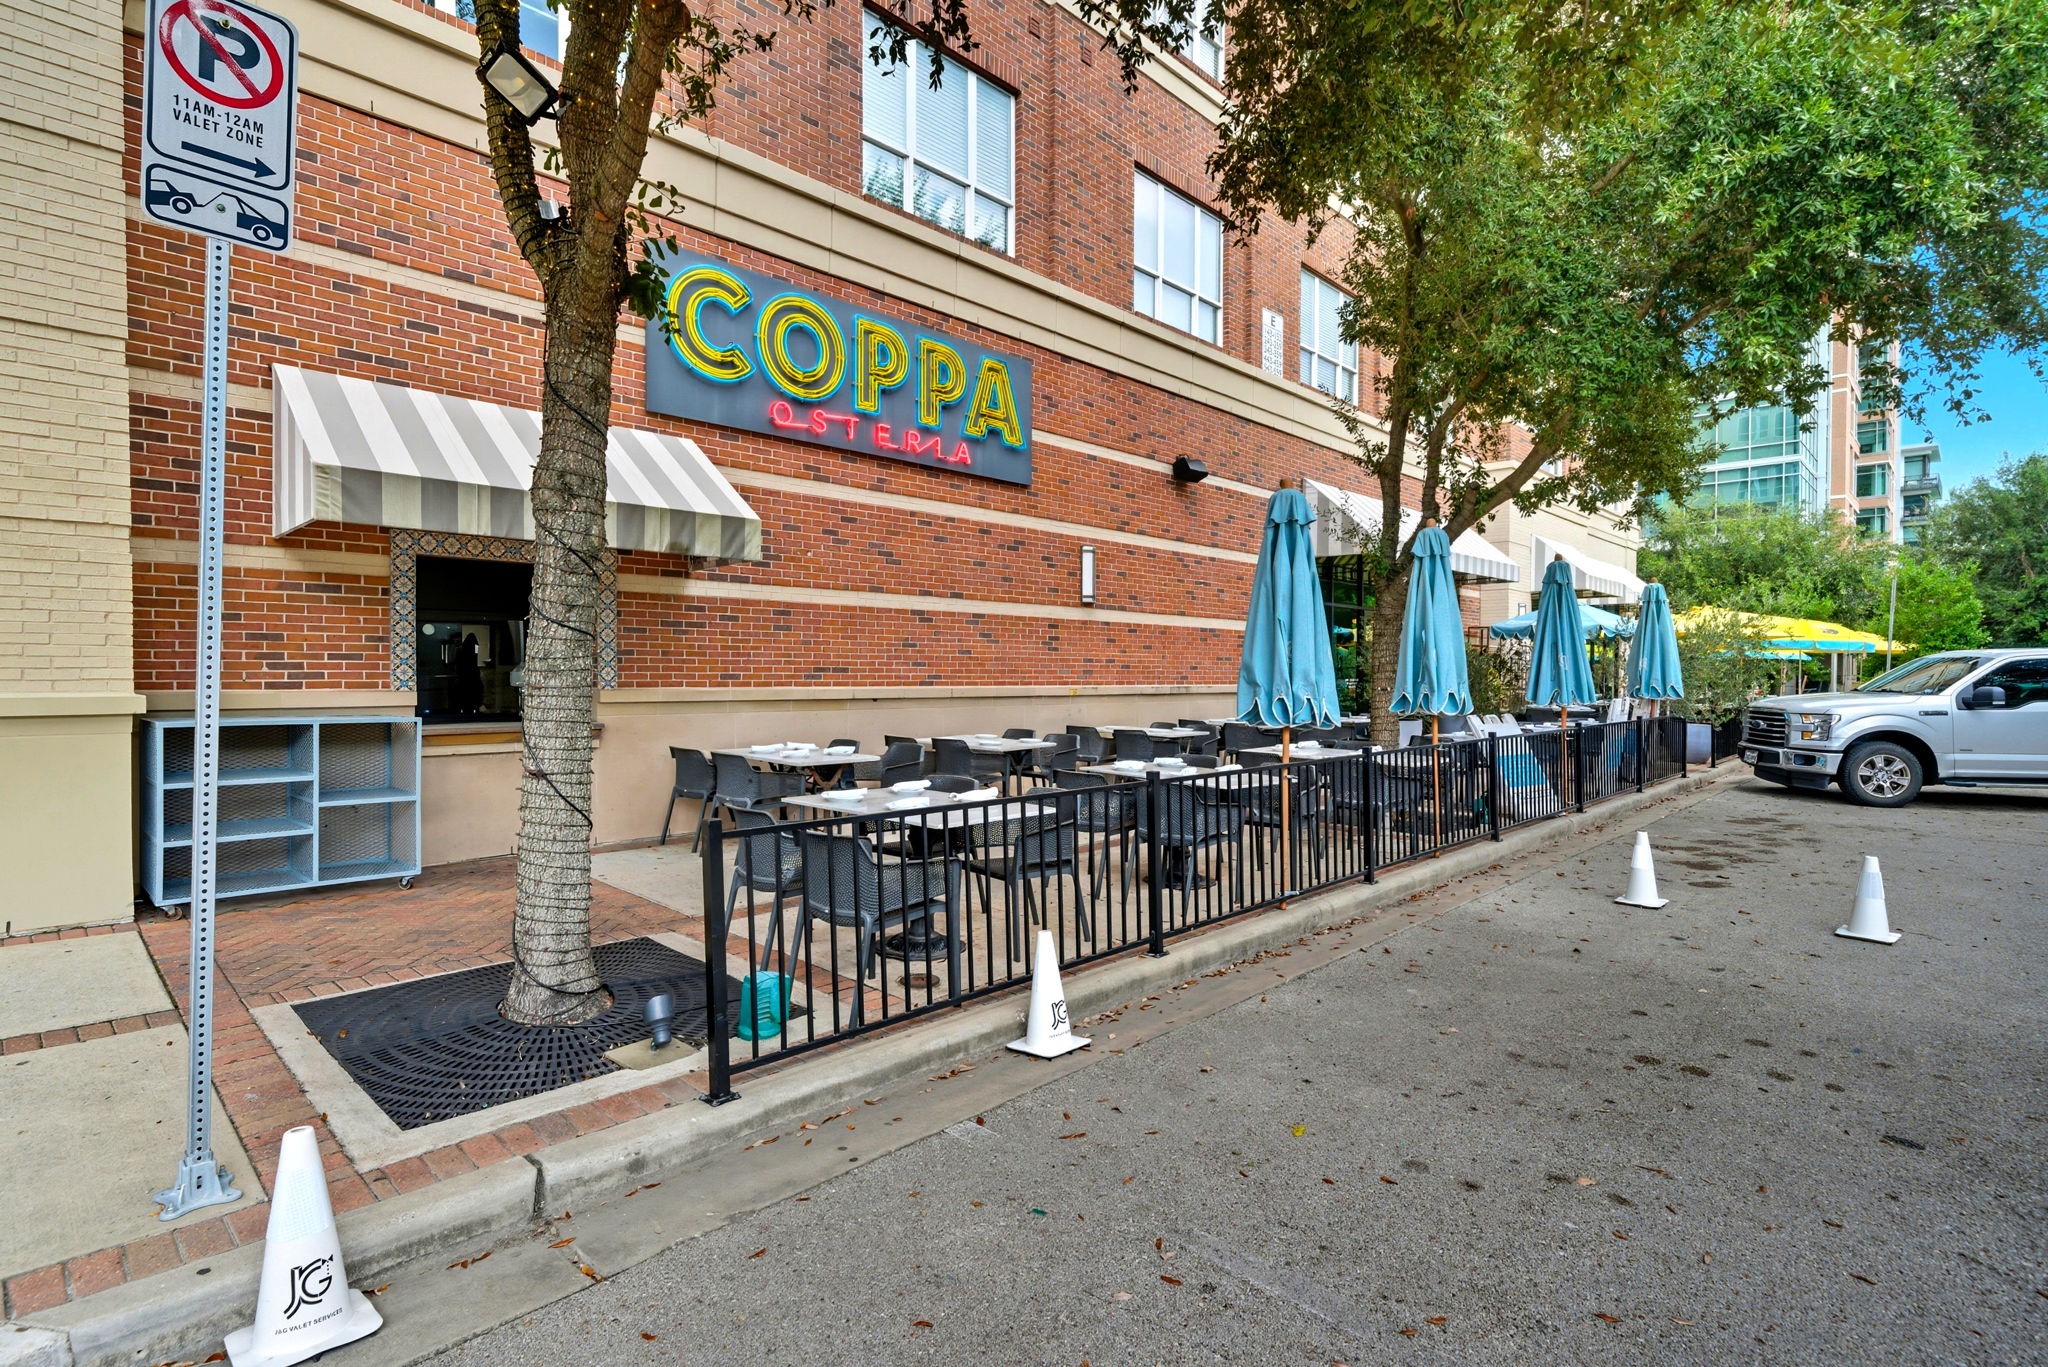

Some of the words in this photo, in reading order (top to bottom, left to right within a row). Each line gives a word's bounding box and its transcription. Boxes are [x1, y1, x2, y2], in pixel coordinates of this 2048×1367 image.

[172, 93, 265, 135] 11AM-12AM
[172, 107, 219, 133] VALET
[226, 124, 264, 149] ZONE
[1270, 315, 1276, 328] E
[667, 263, 1027, 450] COPPA
[768, 400, 972, 466] OSTERIA
[289, 1320, 312, 1333] VALET
[313, 1307, 343, 1325] SERVICES
